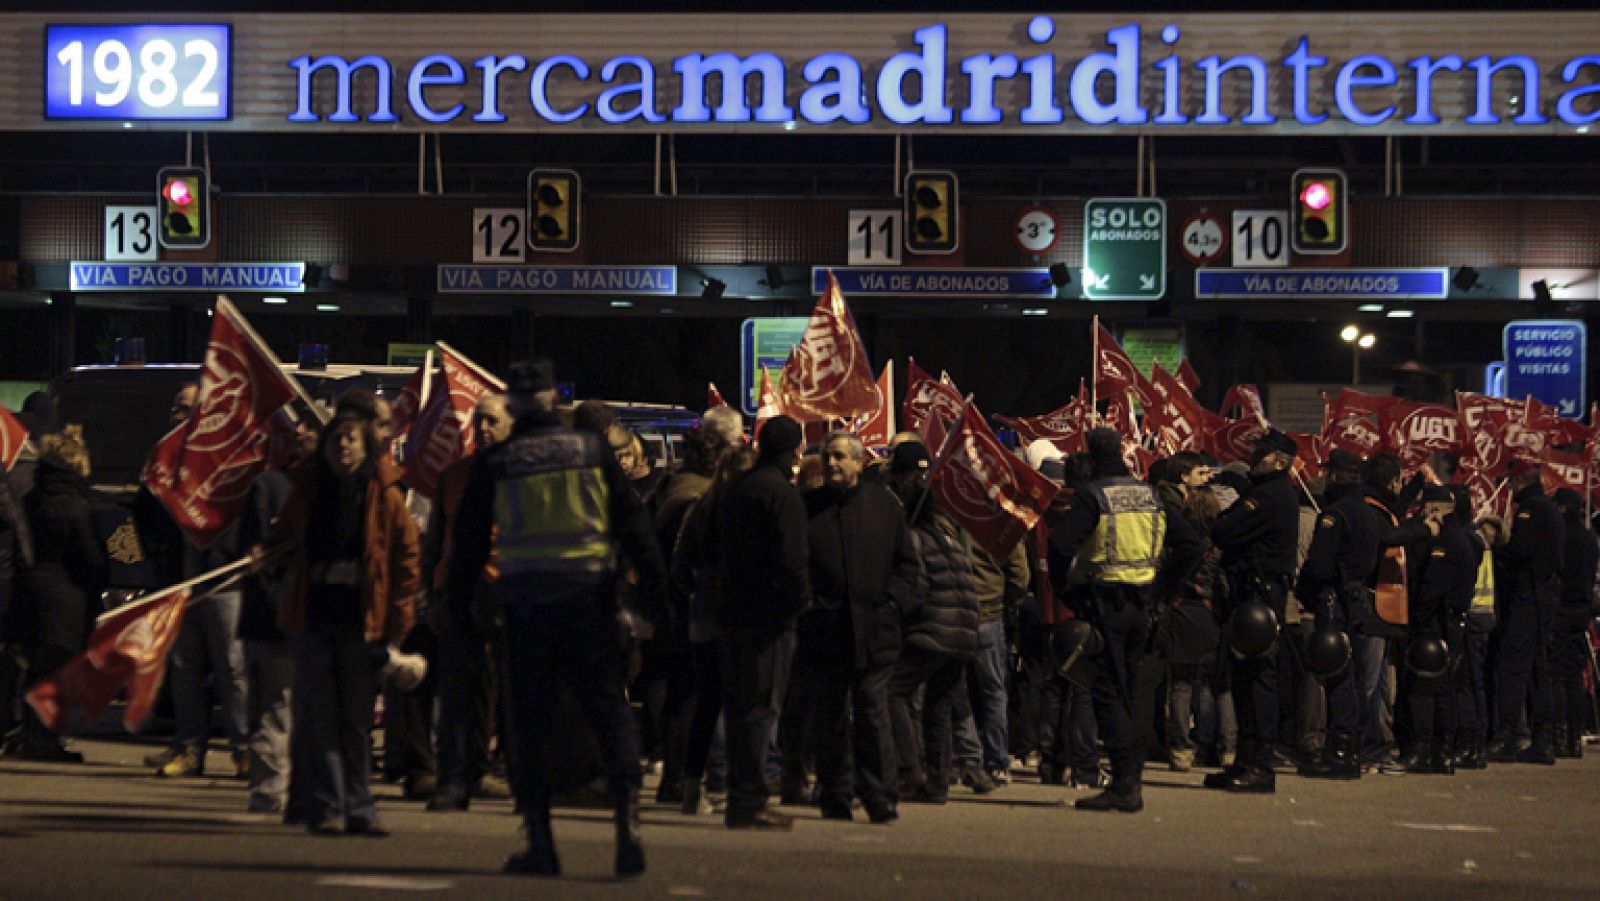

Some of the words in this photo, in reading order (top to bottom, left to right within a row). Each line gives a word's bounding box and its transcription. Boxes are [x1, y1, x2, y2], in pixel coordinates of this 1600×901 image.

[56, 40, 219, 108] 1982
[1091, 207, 1161, 228] SOLO
[110, 211, 152, 254] 13
[478, 214, 521, 257] 12
[857, 215, 894, 259] 11
[1091, 229, 1160, 241] ABONADOS
[1238, 216, 1283, 261] 10
[128, 265, 187, 285] PAGO
[201, 265, 298, 286] MANUAL
[497, 269, 557, 288] PAGO
[572, 270, 669, 289] MANUAL
[859, 272, 886, 290] VÍA
[890, 275, 912, 290] DE
[916, 276, 1009, 291] ABONADOS
[1243, 274, 1271, 292] VÍA
[1275, 276, 1297, 292] DE
[1302, 276, 1399, 292] ABONADOS
[1514, 329, 1575, 341] SERVICIO
[1515, 342, 1573, 357] PÚBLICO
[1518, 362, 1570, 374] VISITAS
[1410, 416, 1457, 443] UGT
